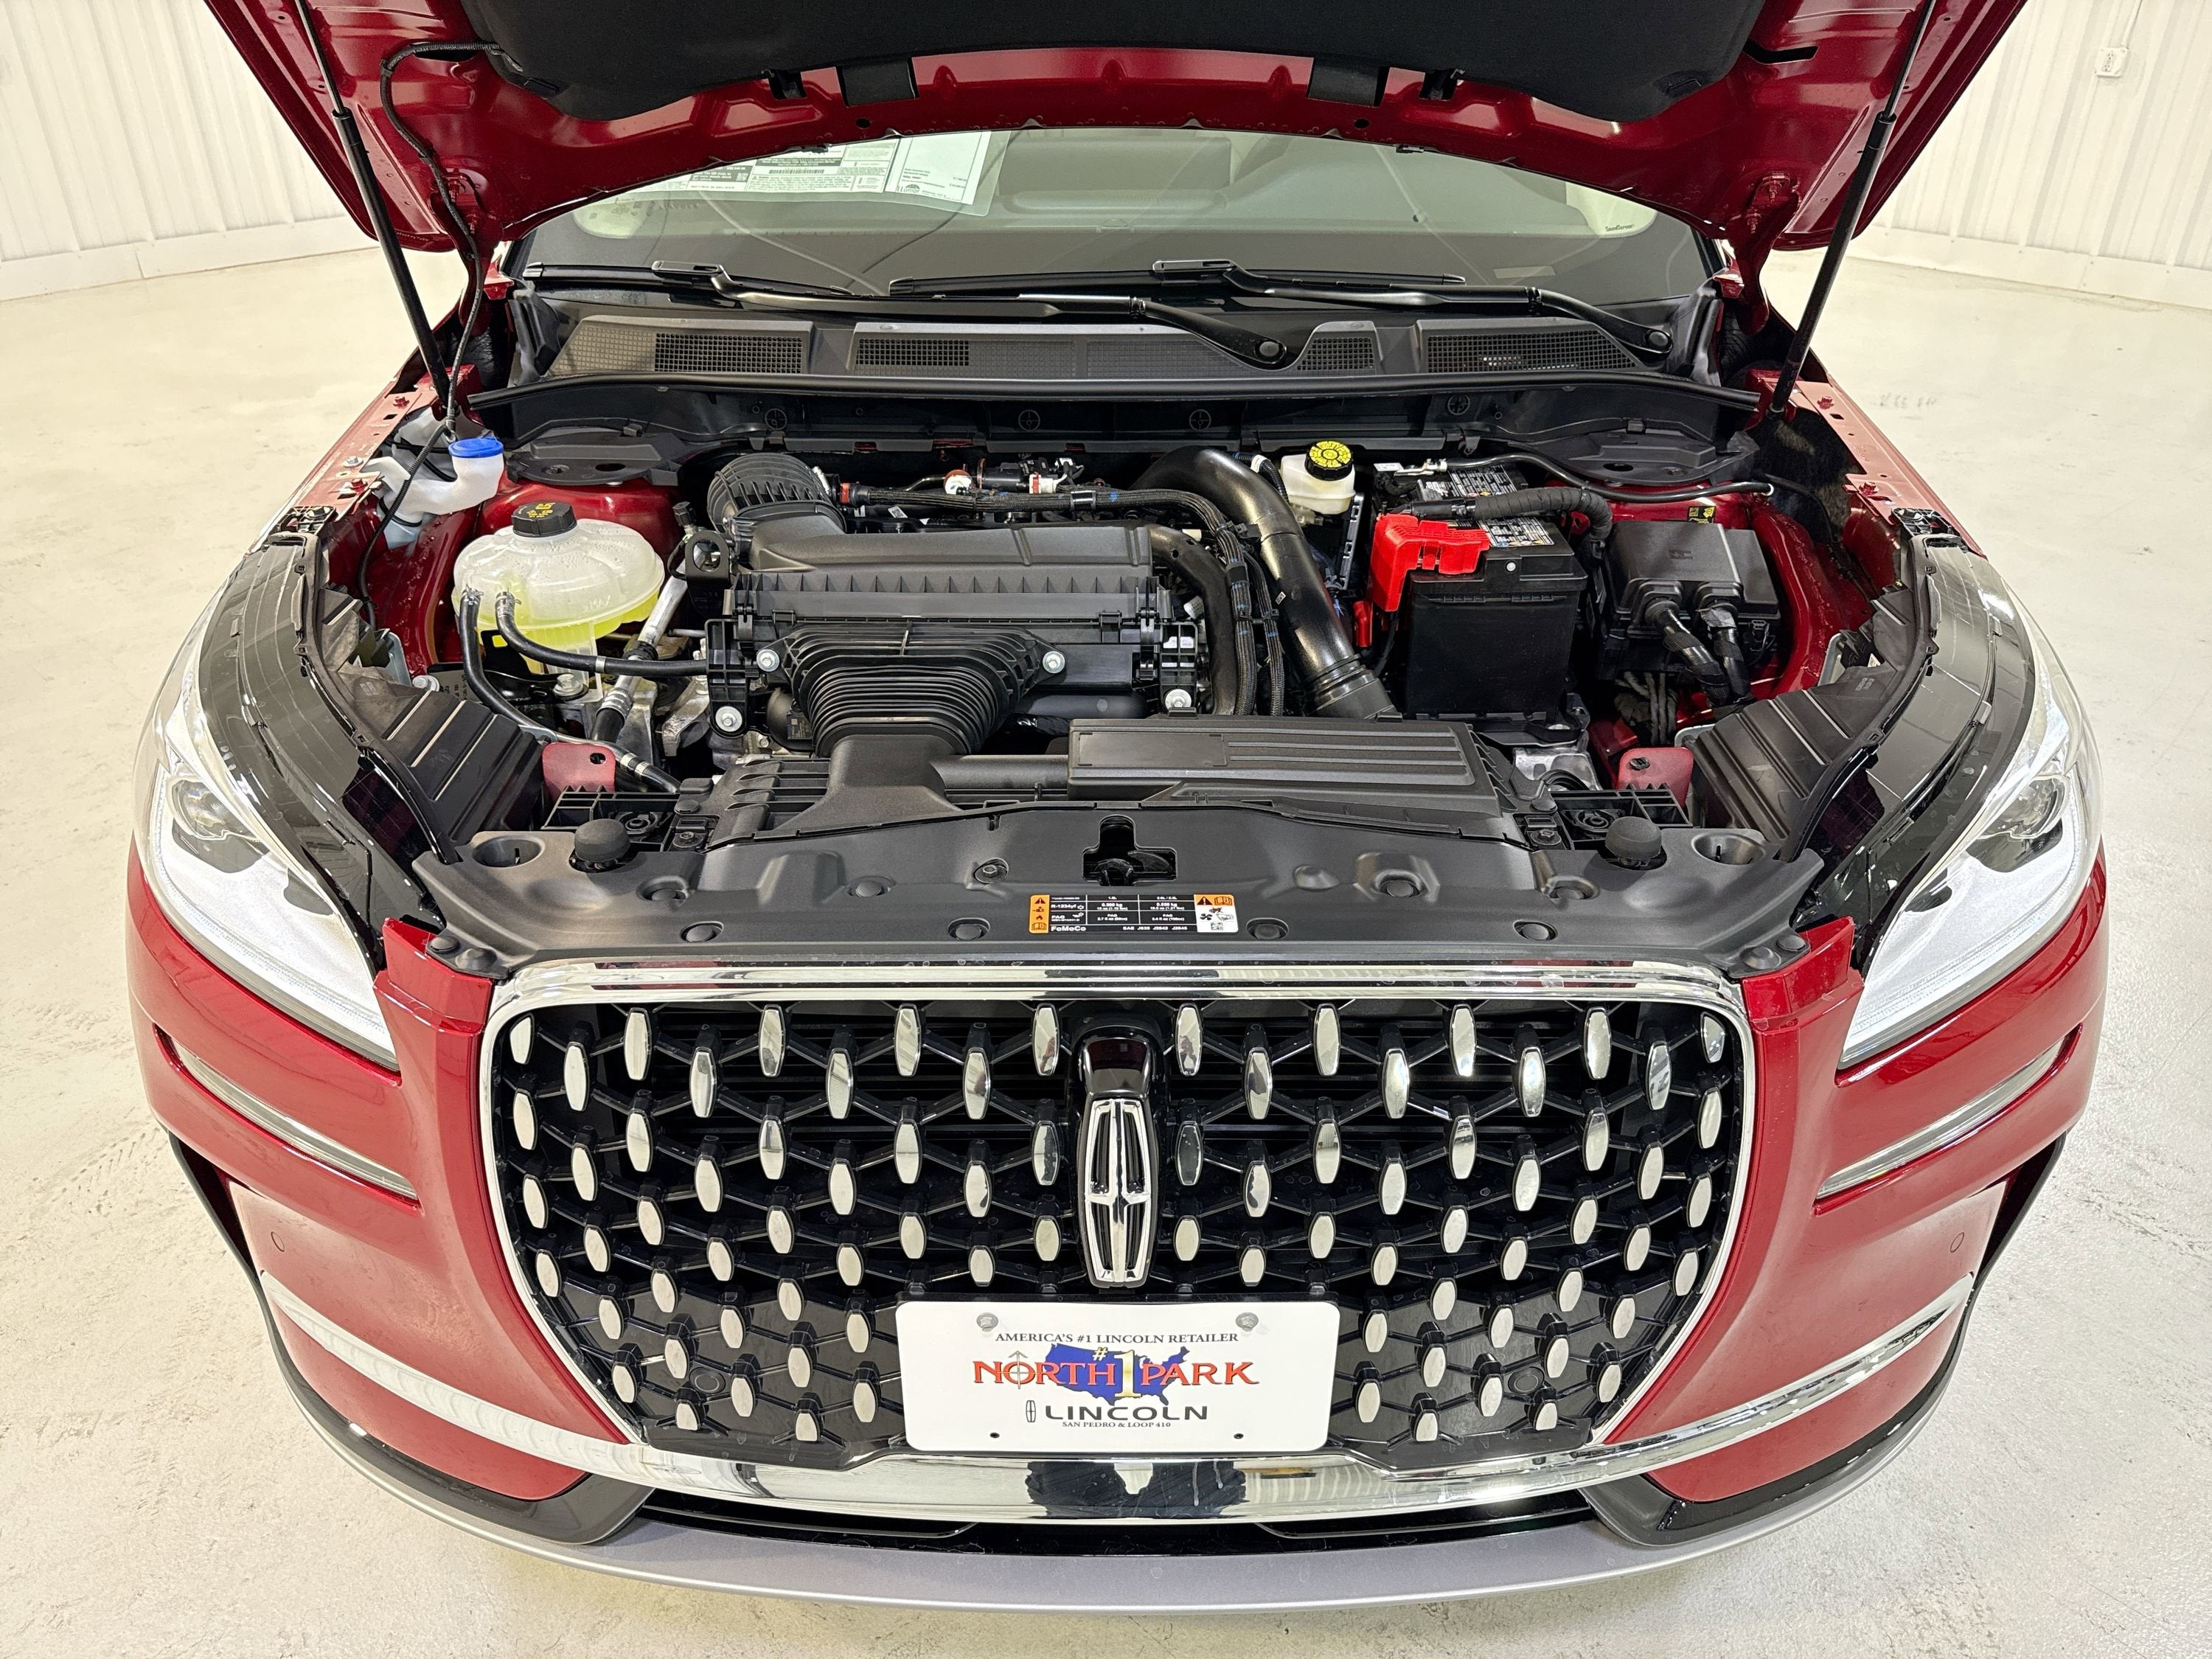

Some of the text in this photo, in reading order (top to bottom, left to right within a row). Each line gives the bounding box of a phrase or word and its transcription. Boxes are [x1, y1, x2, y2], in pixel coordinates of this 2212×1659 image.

[995, 1333, 1239, 1343] AMERICA'S #1 LINCOLN RETAILER
[973, 1360, 1260, 1386] NORTH PARK
[1046, 1405, 1208, 1421] LINCOLN
